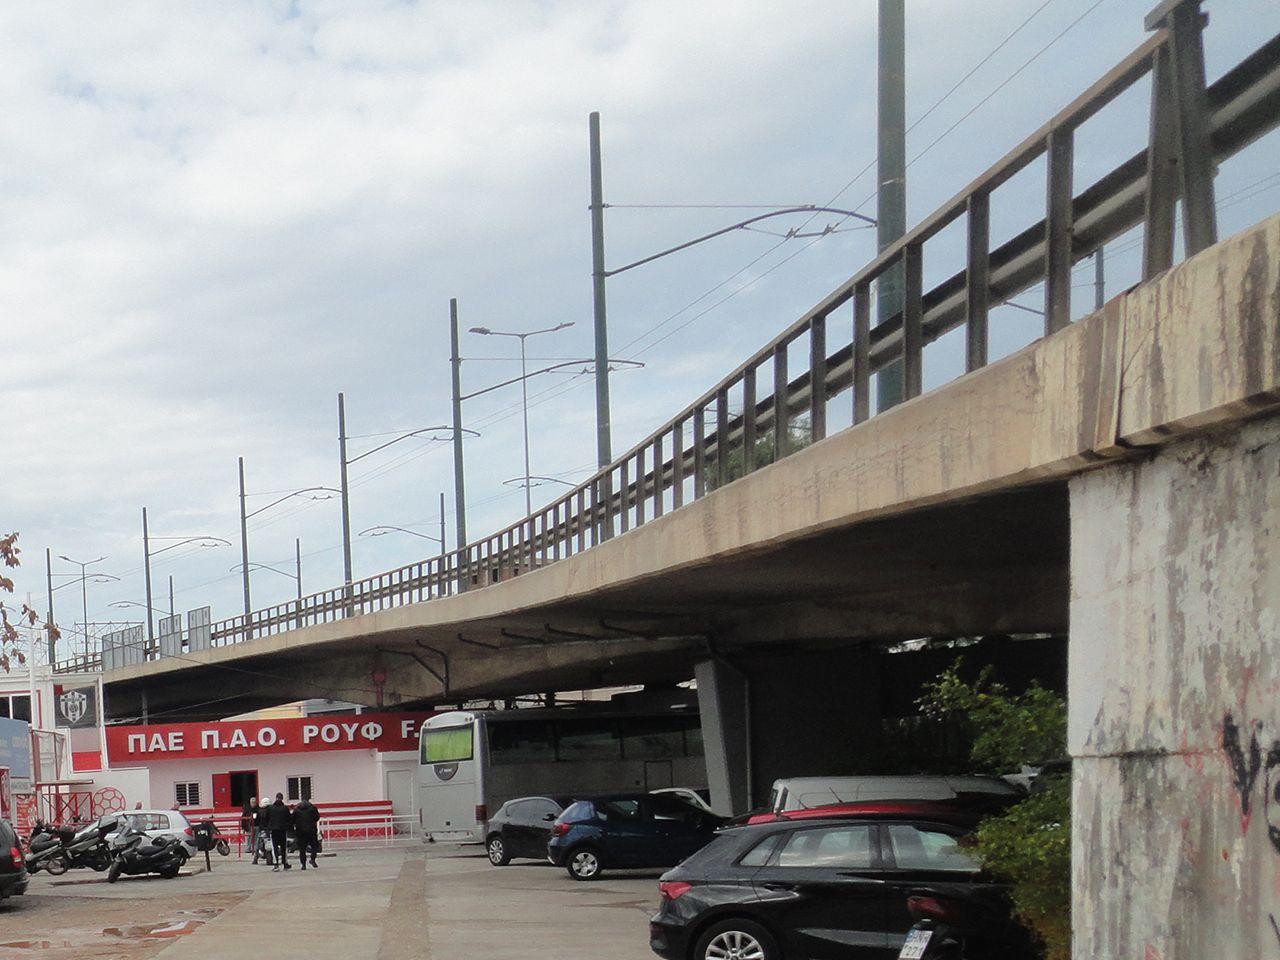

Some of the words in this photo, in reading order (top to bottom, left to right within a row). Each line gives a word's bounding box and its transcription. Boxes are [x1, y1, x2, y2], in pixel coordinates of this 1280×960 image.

[128, 731, 184, 753] ΠΑΕ
[201, 726, 285, 749] Π.Α.Ο.
[303, 721, 382, 744] ΡΟΥΦ
